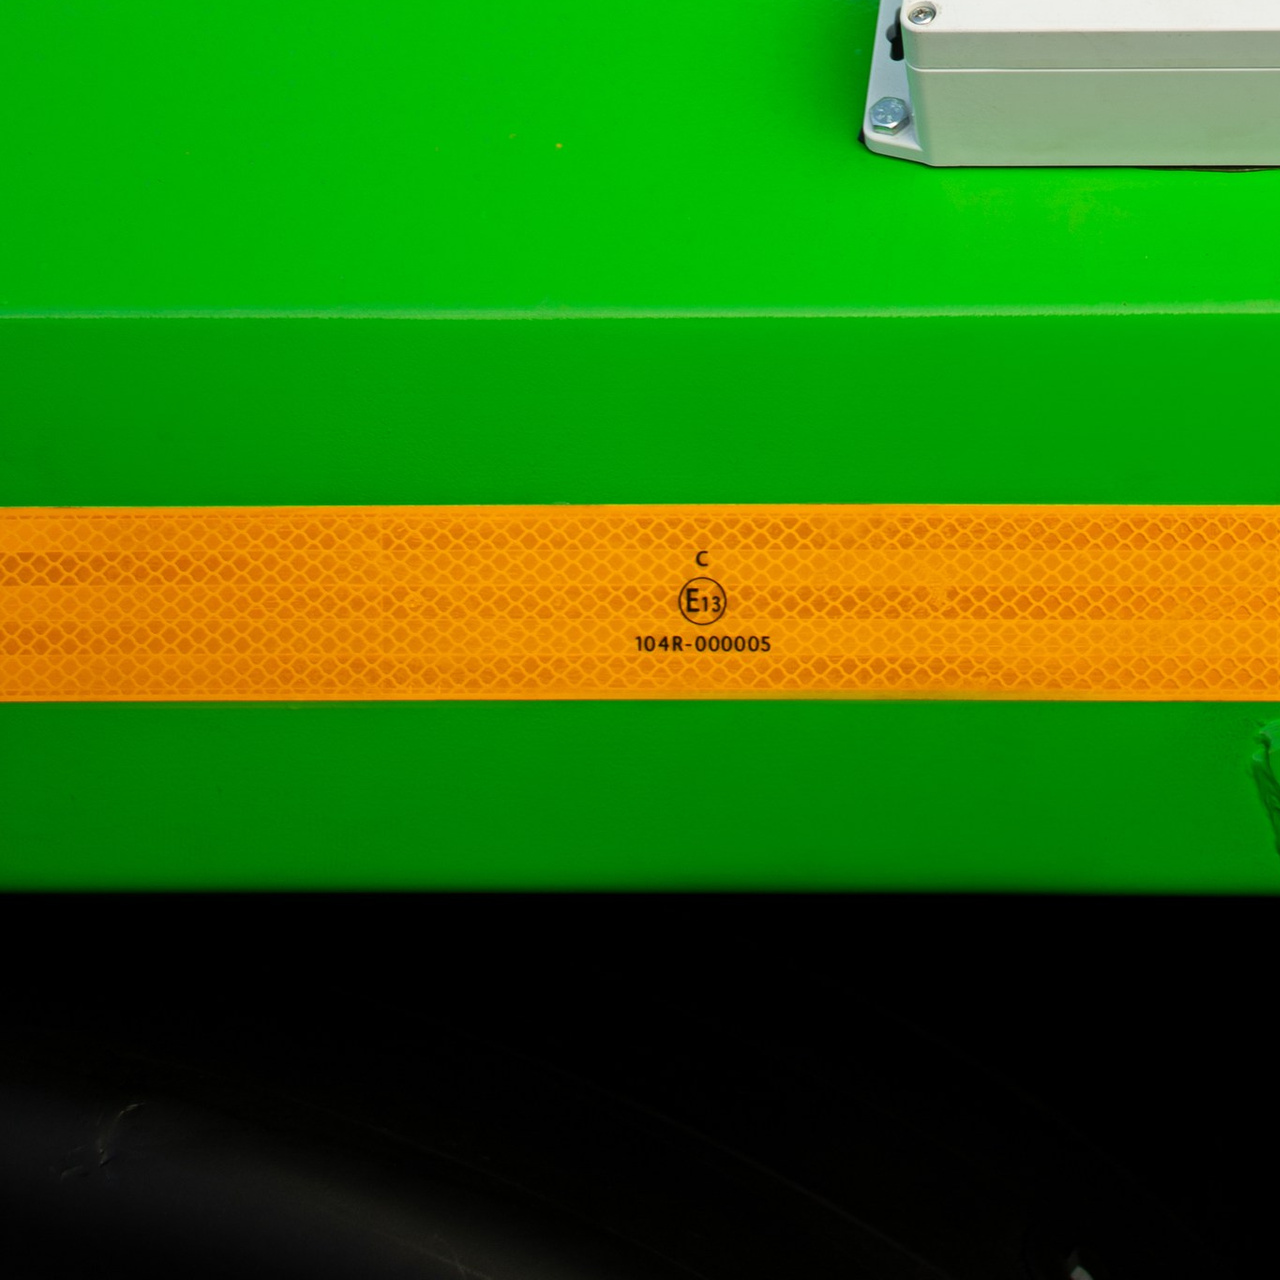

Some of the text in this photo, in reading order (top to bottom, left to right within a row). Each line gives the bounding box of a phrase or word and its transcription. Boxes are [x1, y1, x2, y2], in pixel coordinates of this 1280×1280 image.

[695, 550, 709, 567] C
[686, 587, 721, 613] E13
[635, 635, 772, 653] 104R-000005
